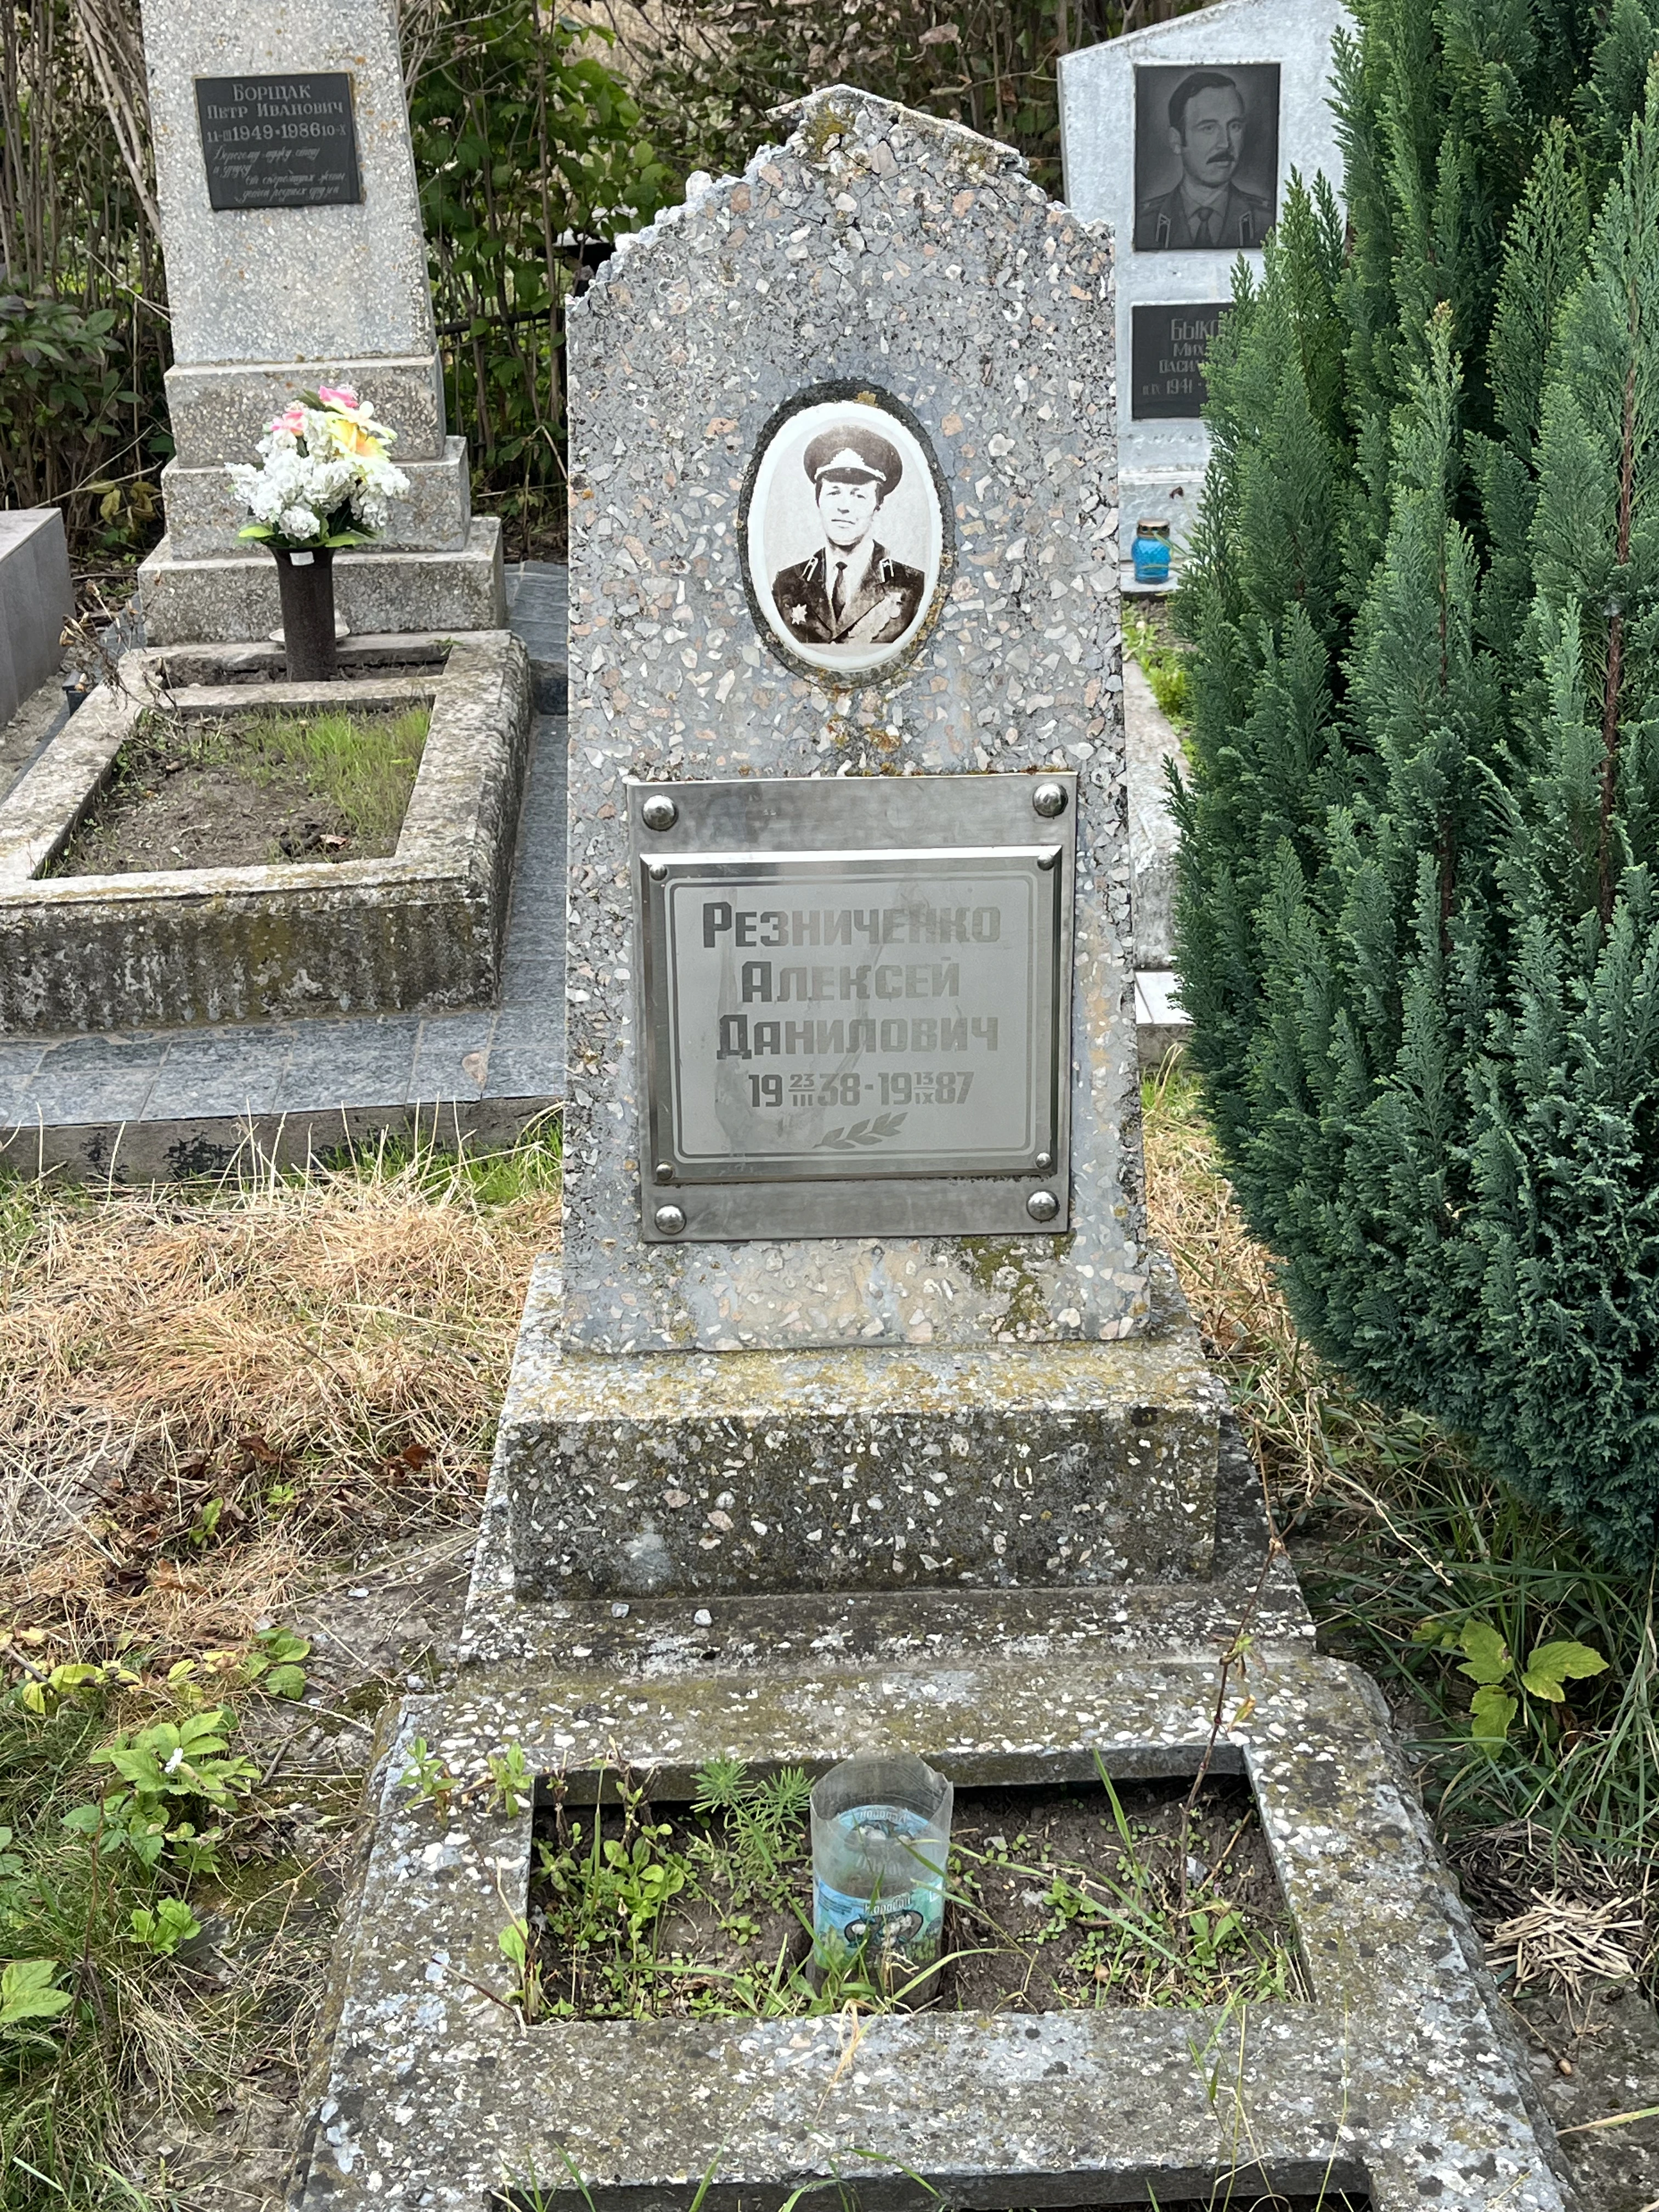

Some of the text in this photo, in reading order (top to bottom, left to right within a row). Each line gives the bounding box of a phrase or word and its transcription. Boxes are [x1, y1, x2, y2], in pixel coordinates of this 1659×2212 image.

[232, 83, 312, 102] БОРЩАК
[257, 101, 343, 117] ИВАНОВИЧ
[1171, 318, 1220, 341] БЫКО
[1173, 342, 1205, 357] МИХ
[1167, 378, 1193, 394] 1941
[702, 900, 1001, 948] РЕЗНИЧЕНКО
[741, 956, 960, 1003] АЛЕКСЕЙ
[716, 1013, 999, 1060] ДАНИЛОВИЧ
